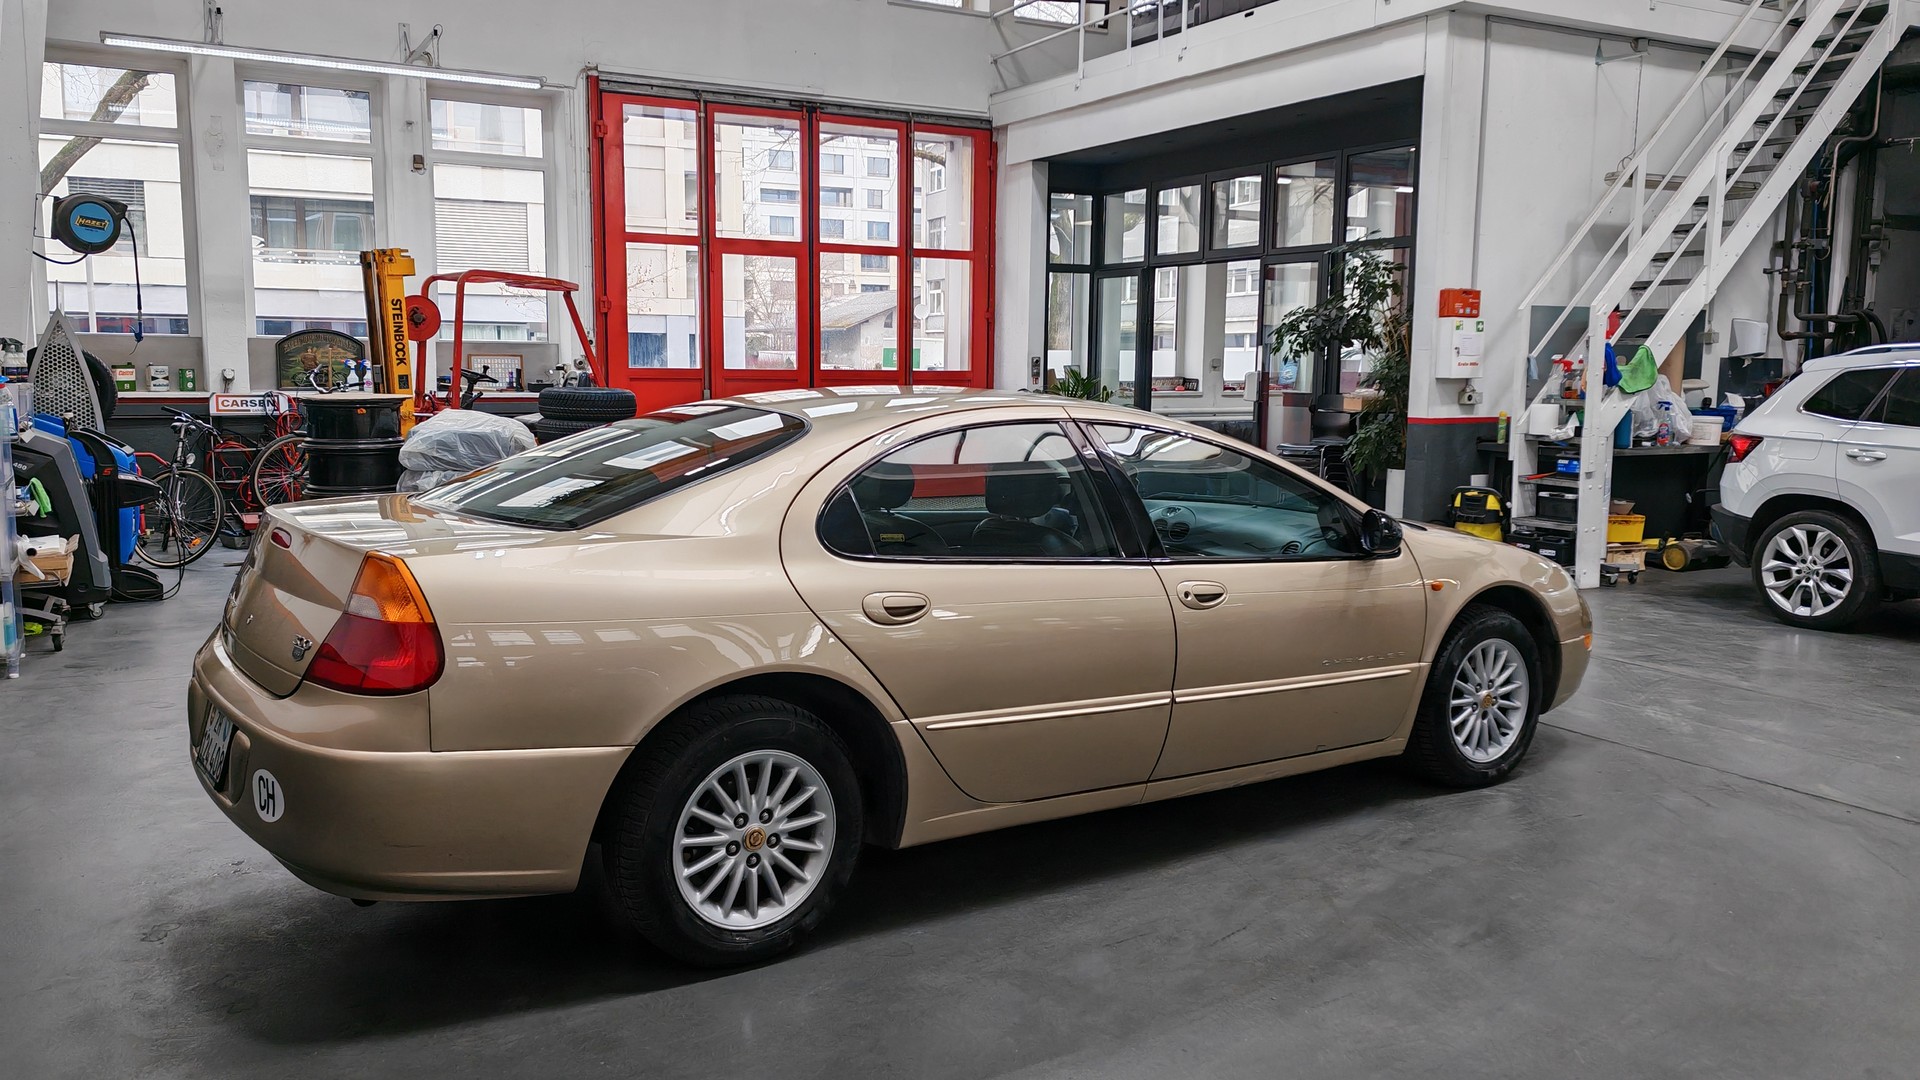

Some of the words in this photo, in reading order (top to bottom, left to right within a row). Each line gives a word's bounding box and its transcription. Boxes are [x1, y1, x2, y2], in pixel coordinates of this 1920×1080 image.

[78, 216, 107, 230] HAZET
[391, 298, 407, 367] STEINBOCK
[258, 775, 276, 818] CH
